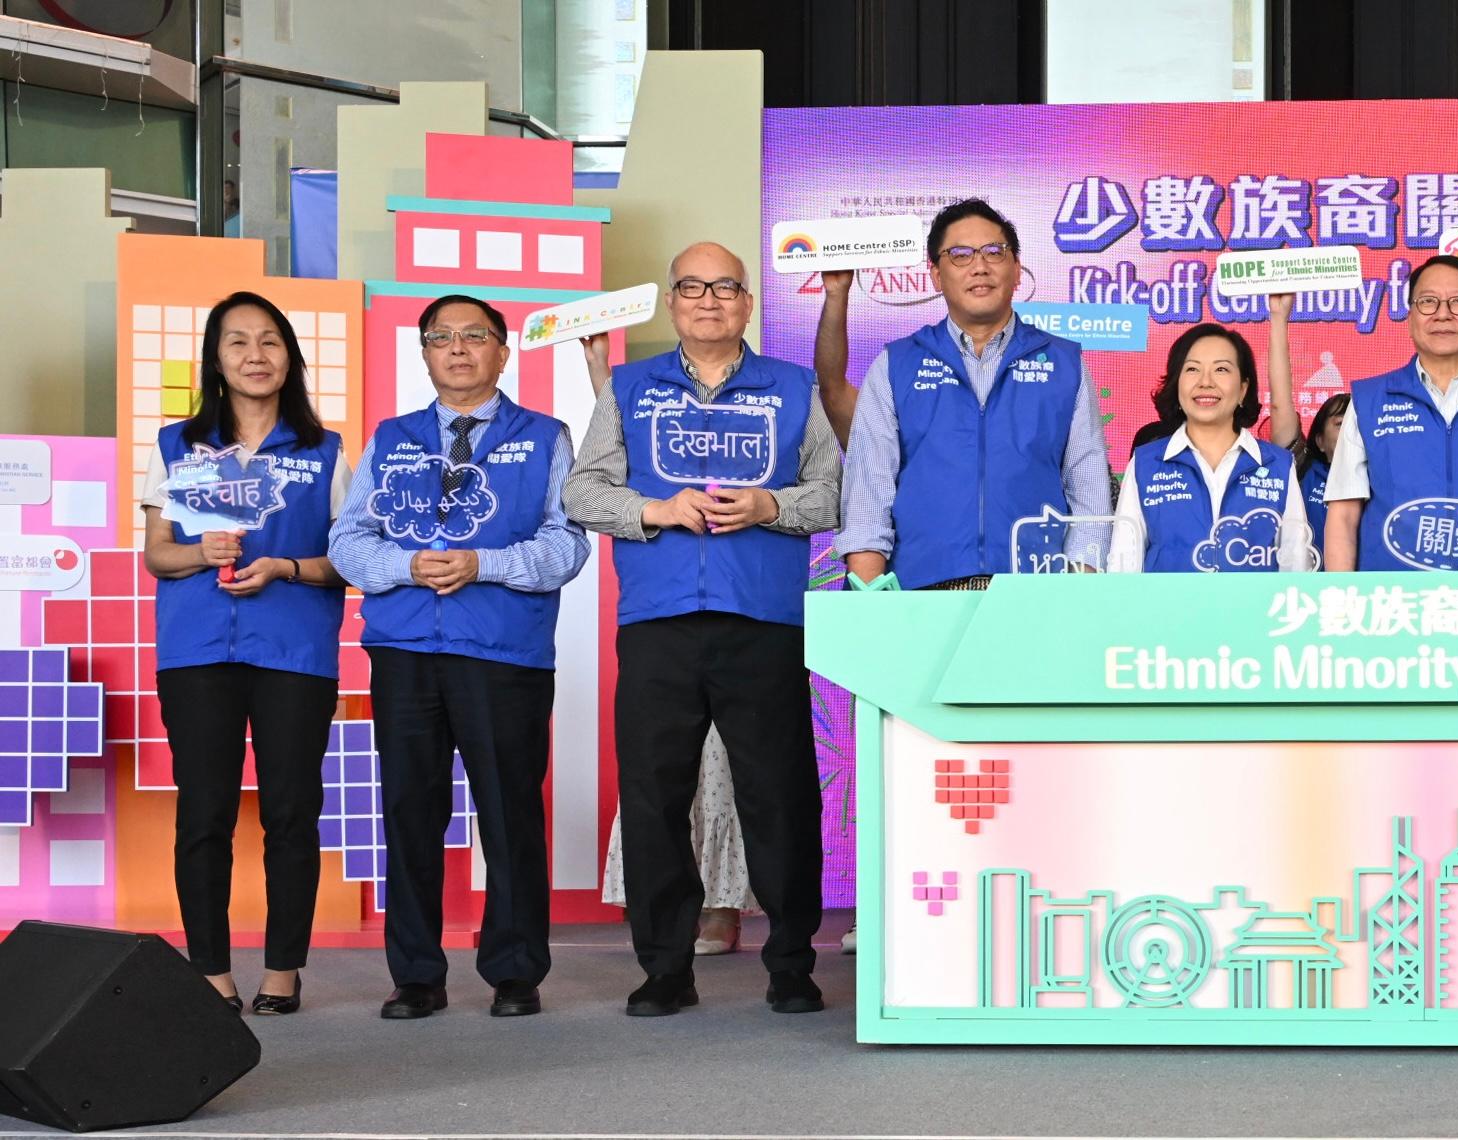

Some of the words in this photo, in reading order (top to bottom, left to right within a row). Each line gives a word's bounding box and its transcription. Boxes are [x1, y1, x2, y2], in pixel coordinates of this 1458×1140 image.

[823, 244, 850, 252] HOME
[853, 241, 886, 250] Centre
[888, 239, 916, 248] (SSP)
[1220, 260, 1266, 279] HOPE
[1271, 258, 1300, 268] Support
[1302, 256, 1331, 266] Service
[1333, 255, 1357, 264] Centre
[1271, 268, 1285, 278] for
[1287, 265, 1313, 275] Ethnic
[1314, 263, 1358, 274] Minorities
[1073, 261, 1198, 314] Kick-off
[1068, 315, 1133, 332] Centre
[645, 387, 675, 396] Ethnic
[914, 381, 937, 390] Care
[733, 392, 783, 408] 少數族裔
[1382, 402, 1413, 412] Ethnic
[1377, 412, 1420, 426] Minority
[1373, 426, 1395, 438] Care
[1397, 424, 1424, 433] Team
[666, 420, 764, 459] देखभाल
[1153, 470, 1183, 481] Ethnic
[1146, 481, 1188, 493] Minority
[1245, 486, 1280, 502] 關愛隊
[1143, 495, 1164, 507] Care
[1165, 492, 1193, 502] Team
[1105, 646, 1261, 690] Ethnic
